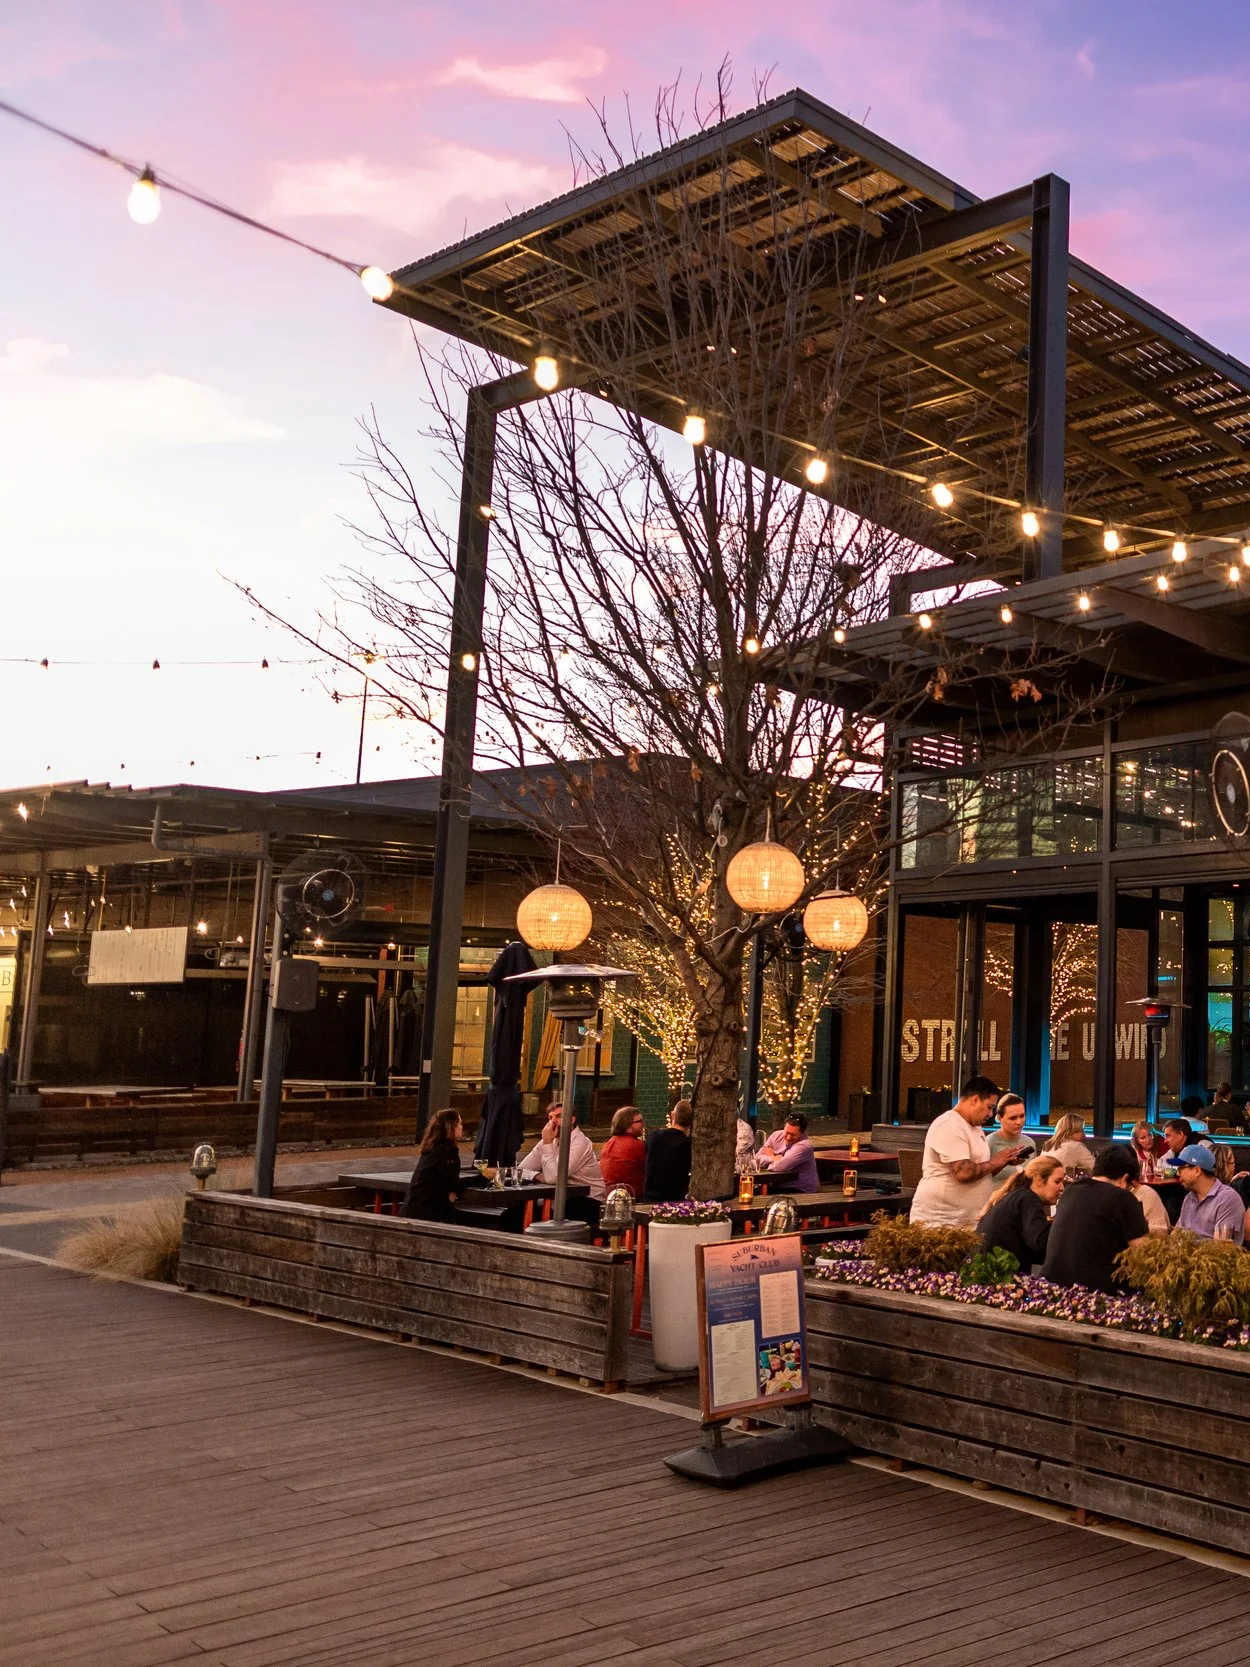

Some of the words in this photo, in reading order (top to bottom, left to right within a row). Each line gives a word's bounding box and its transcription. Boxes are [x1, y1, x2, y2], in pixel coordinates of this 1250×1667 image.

[901, 1018, 1001, 1063] STRLL
[732, 1244, 776, 1261] SUBURBAN
[730, 1262, 755, 1273] YACHT
[758, 1259, 780, 1269] CLUB
